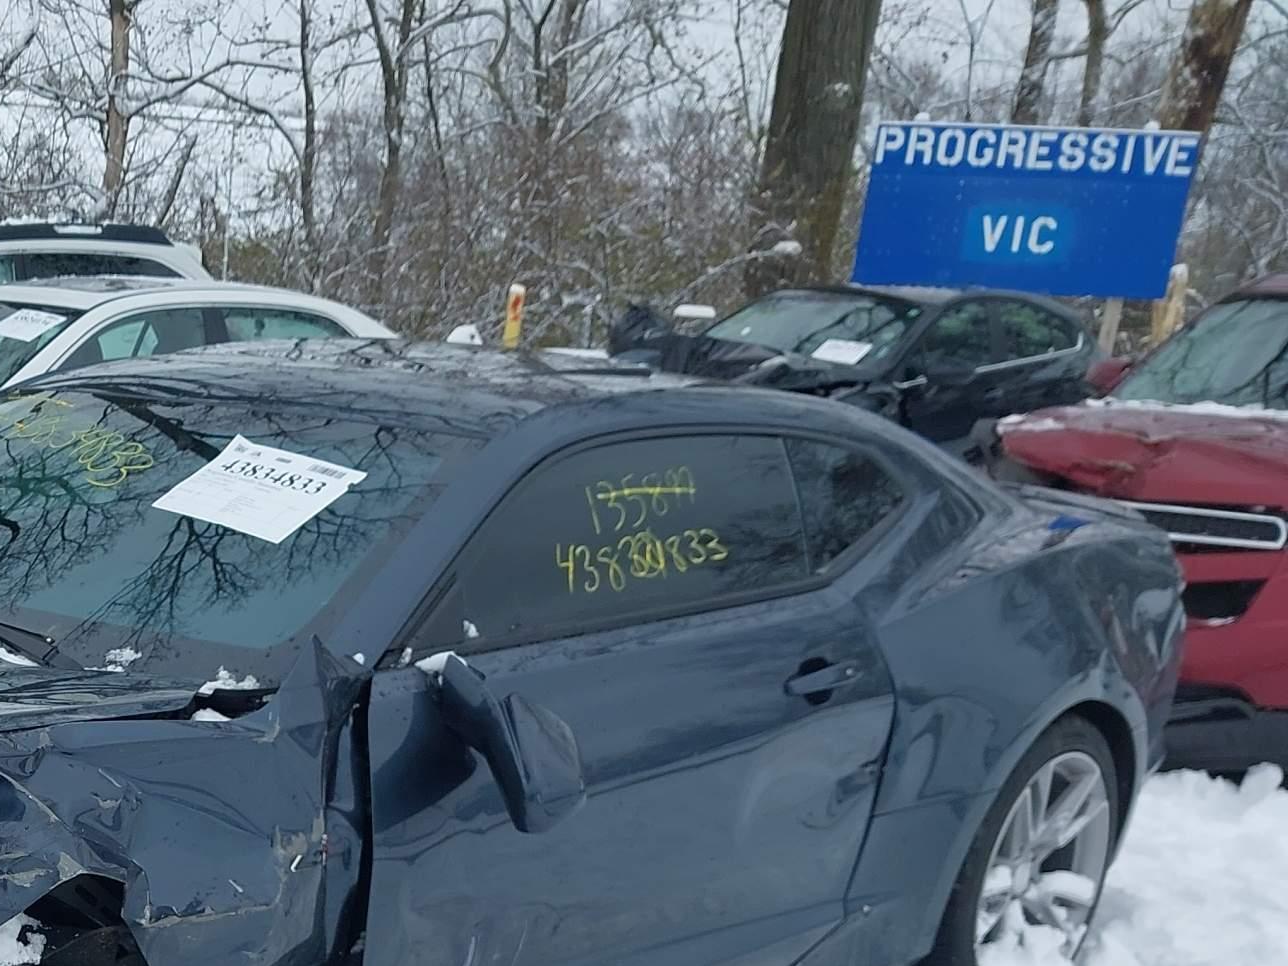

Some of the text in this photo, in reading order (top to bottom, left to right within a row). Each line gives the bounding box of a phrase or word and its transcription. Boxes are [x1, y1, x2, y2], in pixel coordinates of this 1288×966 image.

[875, 127, 1198, 176] PROGRESSIVE
[982, 214, 1058, 254] VIC
[221, 458, 328, 496] 43834833
